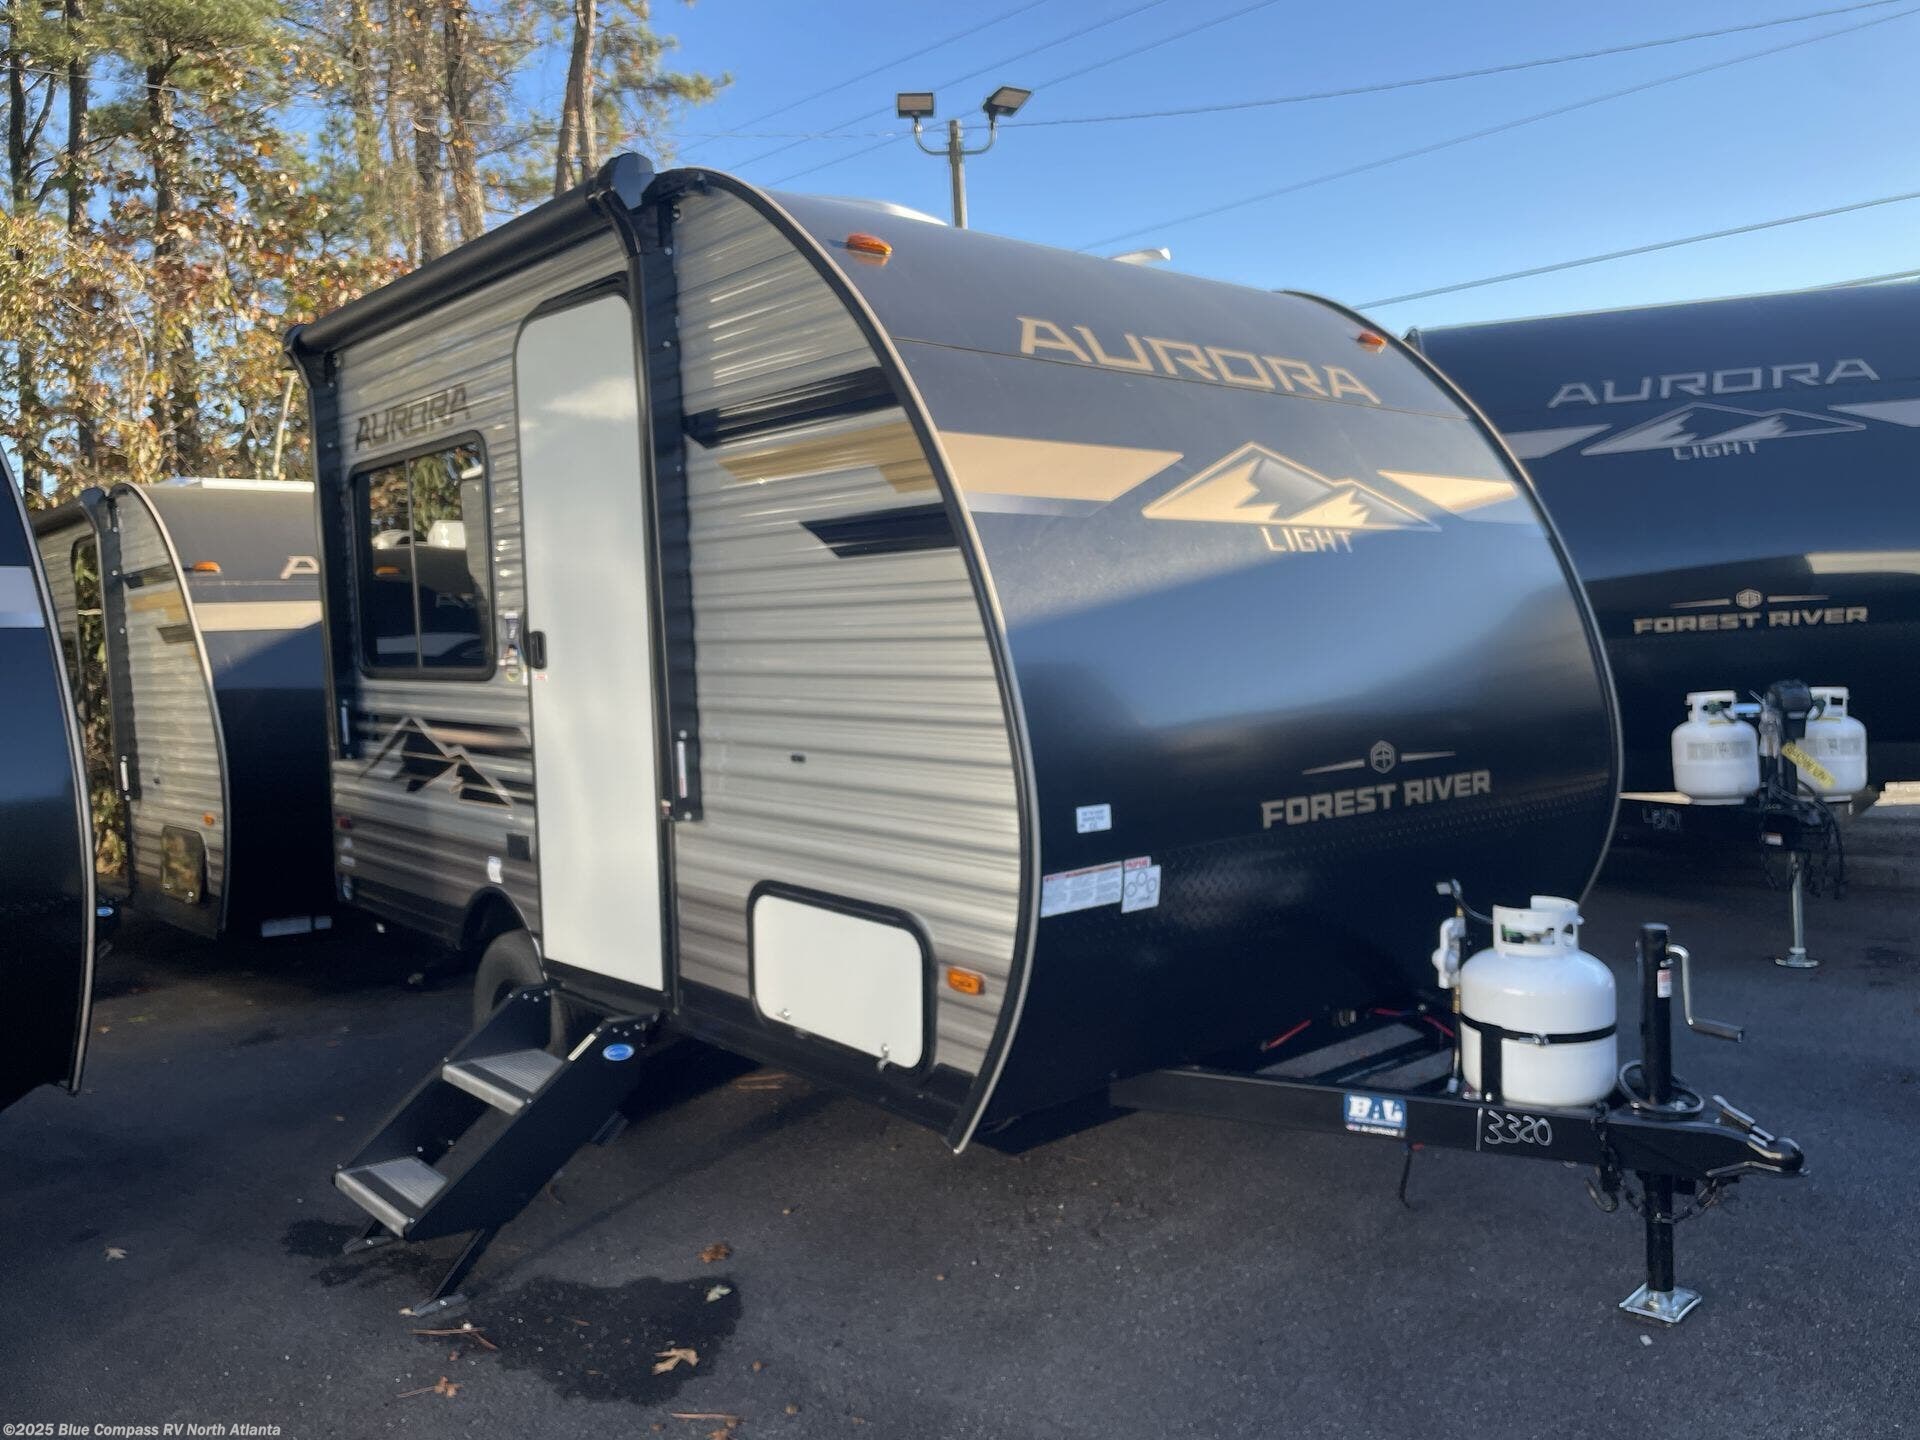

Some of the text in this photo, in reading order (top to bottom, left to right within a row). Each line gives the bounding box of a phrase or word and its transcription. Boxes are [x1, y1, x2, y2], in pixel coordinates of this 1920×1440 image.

[1017, 317, 1381, 404] AURORA
[1547, 359, 1881, 408] AURORA
[355, 383, 470, 449] AURORA
[1672, 441, 1759, 461] LIGHT
[1261, 526, 1354, 554] LIGHT
[1633, 606, 1868, 635] FOREST RIVER
[1261, 769, 1491, 829] FOREST RIVER
